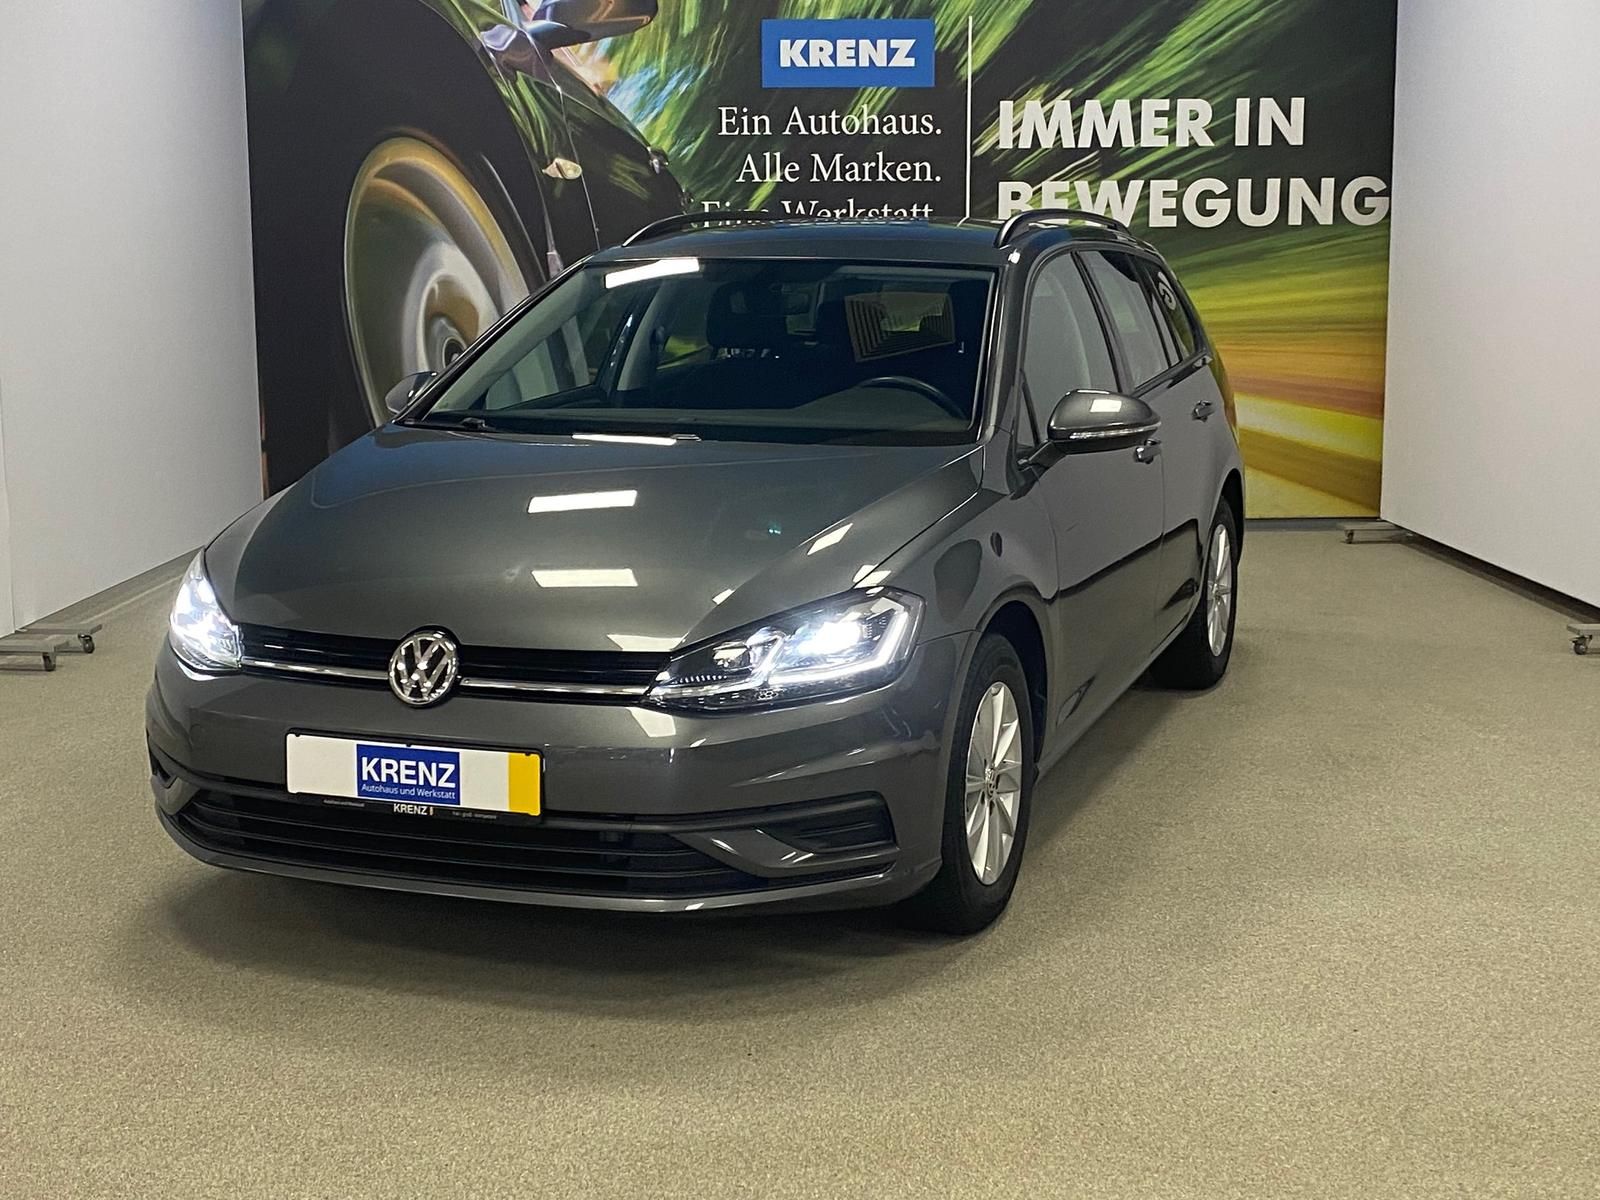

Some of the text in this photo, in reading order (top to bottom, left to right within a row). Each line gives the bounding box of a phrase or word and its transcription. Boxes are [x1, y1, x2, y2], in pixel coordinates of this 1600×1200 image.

[780, 39, 916, 67] KRENZ
[718, 104, 942, 136] Ein Autohaus.
[999, 97, 1305, 148] IMMER IN
[736, 151, 942, 183] Alle Marken.
[701, 201, 769, 227] Ei
[998, 176, 1390, 228] BEWEGUNG
[361, 756, 456, 788] KRENZ
[361, 783, 455, 800] Autohaus und Werkstatt
[393, 803, 428, 816] KRENZ
